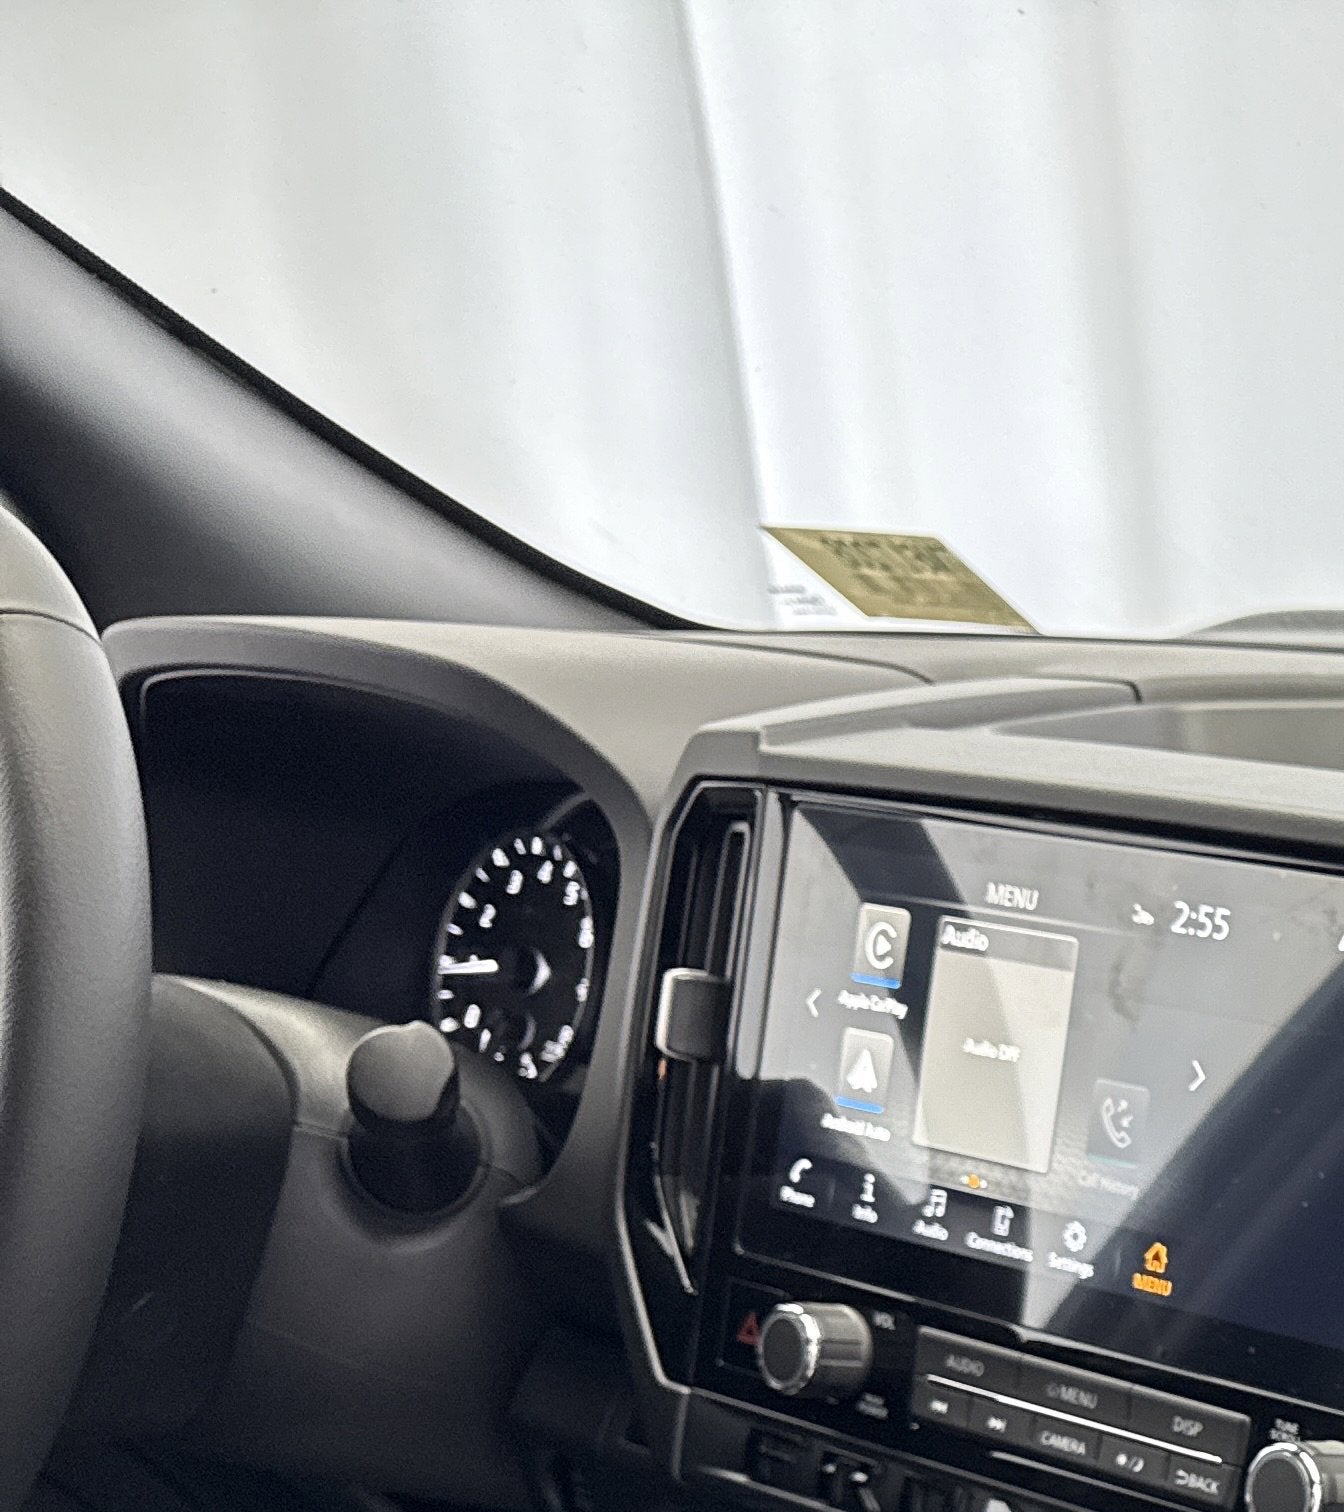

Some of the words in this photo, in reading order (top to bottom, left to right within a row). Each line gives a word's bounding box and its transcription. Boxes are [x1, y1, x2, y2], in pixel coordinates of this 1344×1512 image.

[986, 882, 1040, 911] MENU
[479, 903, 496, 928] 2
[1171, 900, 1231, 941] 2:55
[942, 925, 989, 951] Audio
[1131, 1272, 1173, 1297] MENU
[1059, 1383, 1099, 1409] MENU
[1171, 1414, 1204, 1437] DISP
[1039, 1429, 1087, 1456] CAMERA
[1188, 1473, 1221, 1496] BACK
